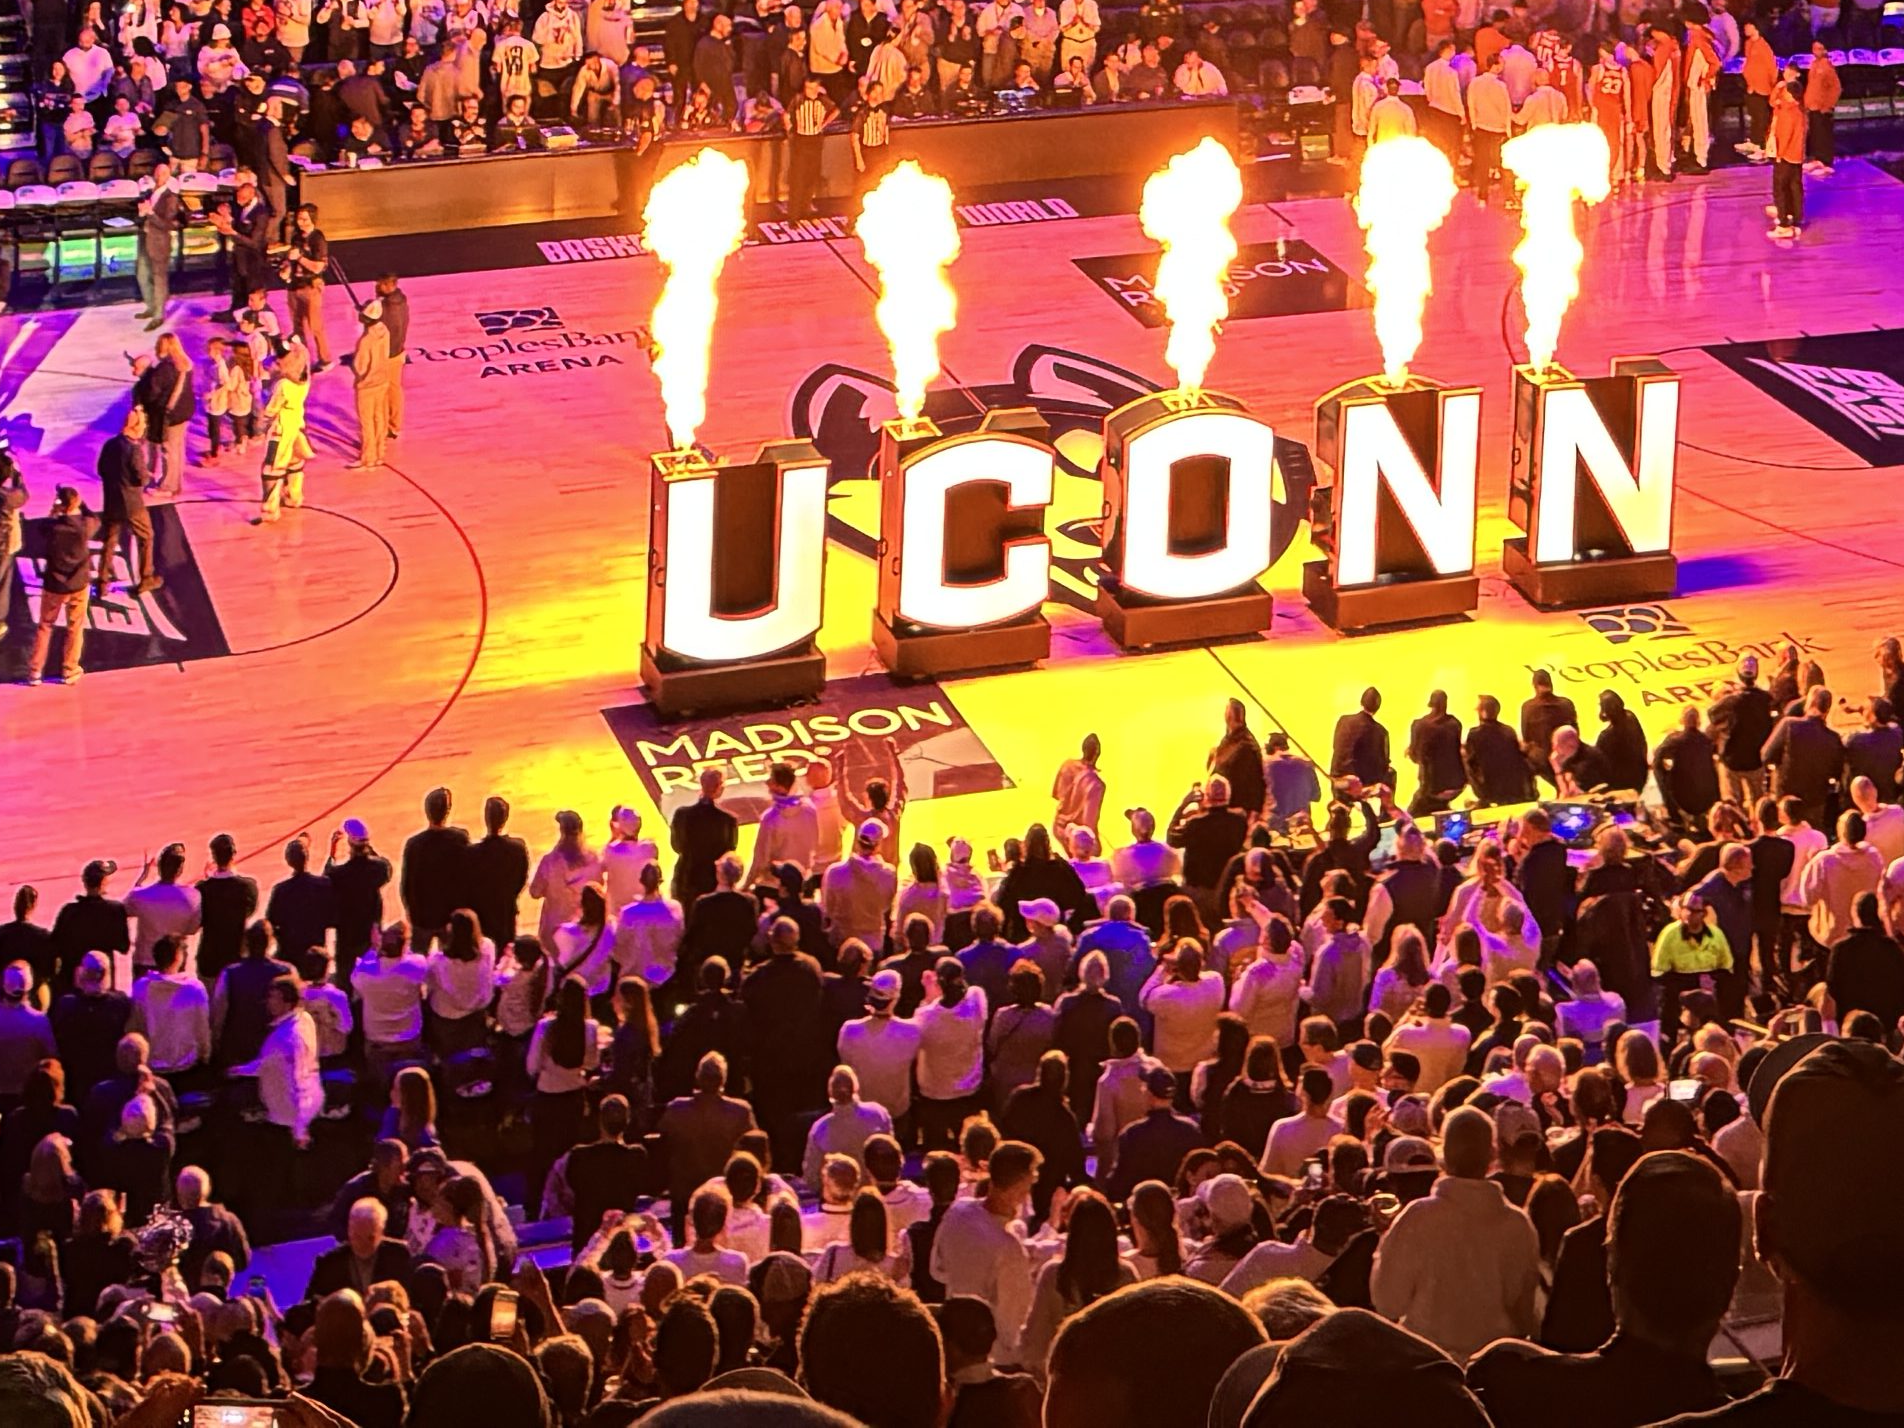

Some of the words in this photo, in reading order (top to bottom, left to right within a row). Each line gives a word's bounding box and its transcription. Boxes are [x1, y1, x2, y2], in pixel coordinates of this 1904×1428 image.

[956, 198, 1080, 226] WORLD
[480, 354, 624, 379] ARENA
[658, 376, 1682, 662] UCONN
[636, 701, 953, 766] MADISON
